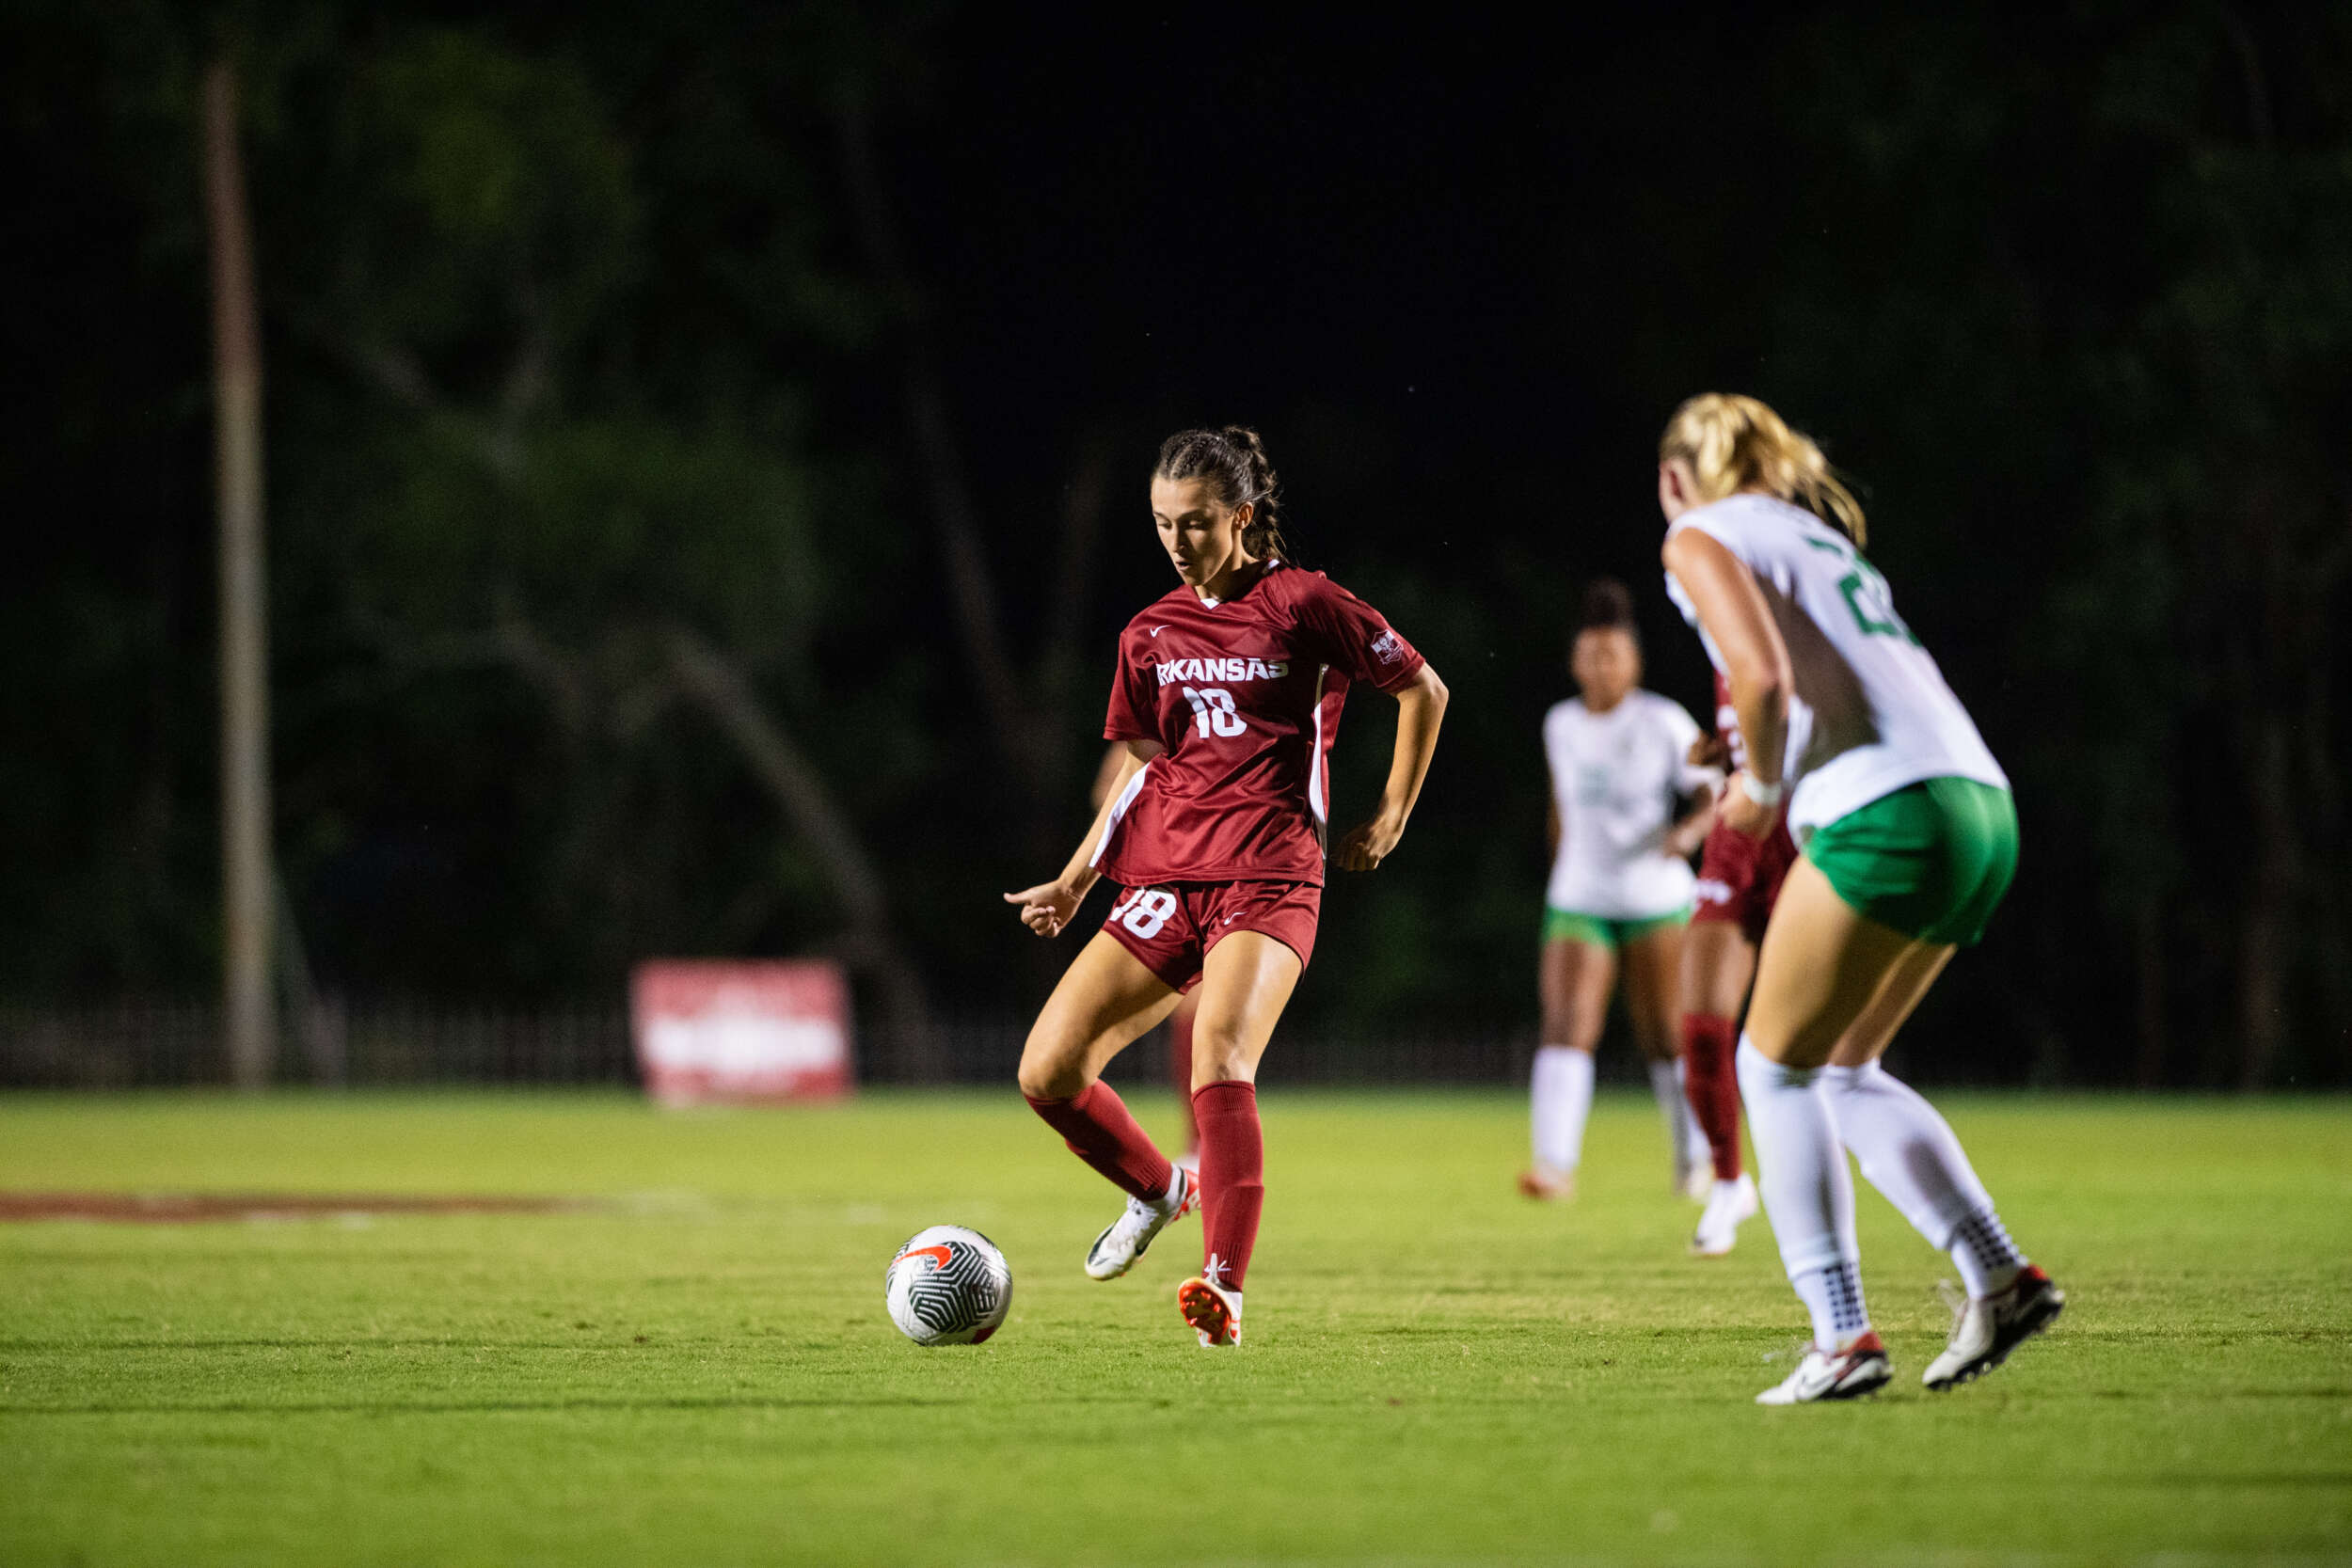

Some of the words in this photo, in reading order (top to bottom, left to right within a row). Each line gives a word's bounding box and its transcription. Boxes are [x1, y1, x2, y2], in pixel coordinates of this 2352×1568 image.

[1156, 657, 1289, 687] RKANSAS
[1183, 687, 1248, 738] 18
[1108, 886, 1176, 939] 18
